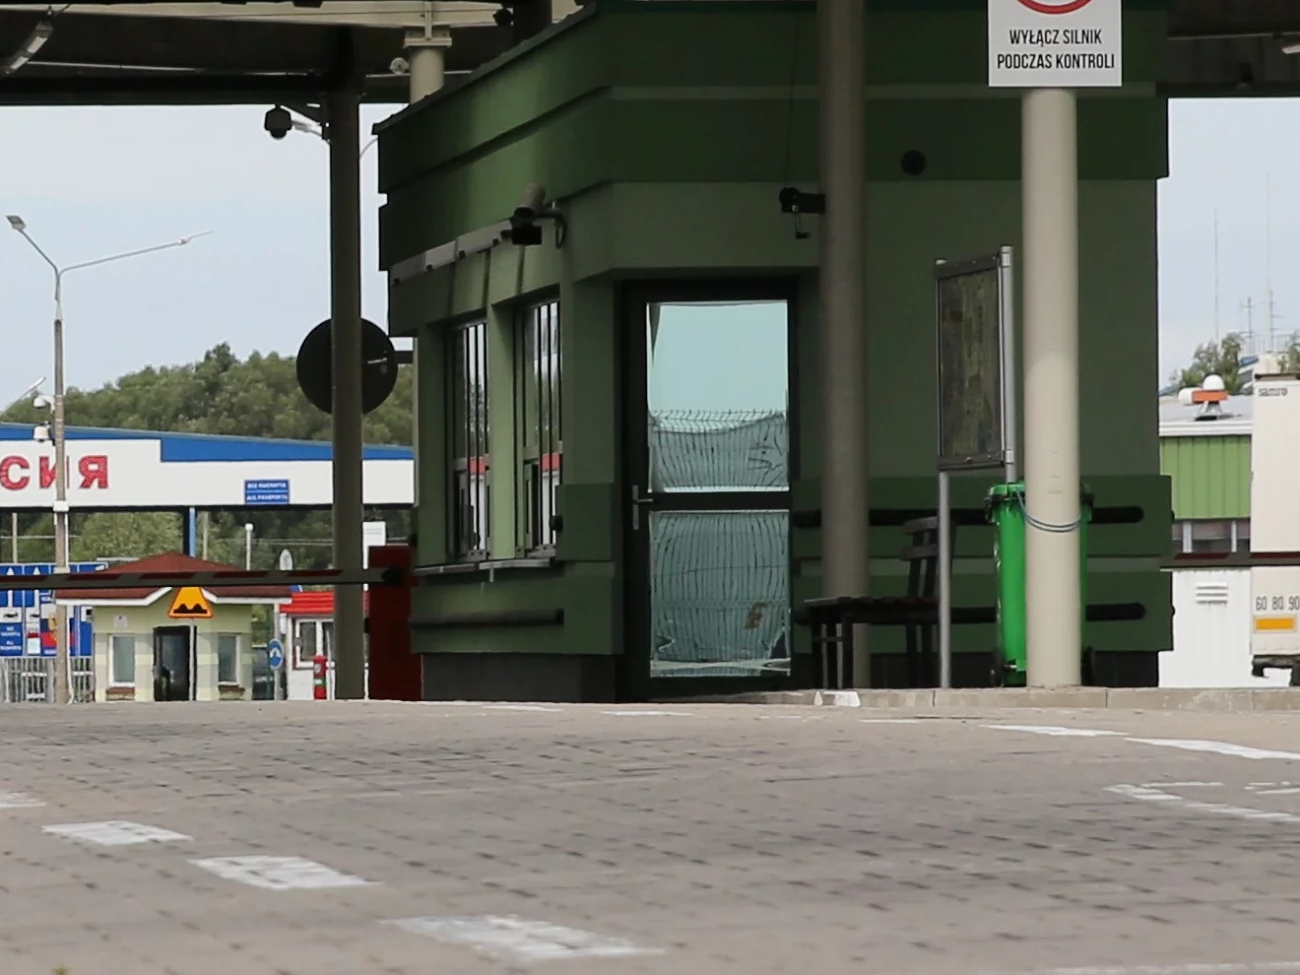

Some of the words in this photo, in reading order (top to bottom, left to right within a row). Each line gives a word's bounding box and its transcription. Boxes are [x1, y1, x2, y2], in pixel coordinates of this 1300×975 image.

[1009, 29, 1060, 47] WYŁĄCZ
[1063, 29, 1103, 44] SILNIK
[997, 54, 1053, 69] PODCZAS
[1056, 53, 1115, 69] KONTROLI
[1256, 596, 1268, 611] 60
[1272, 596, 1284, 611] 80
